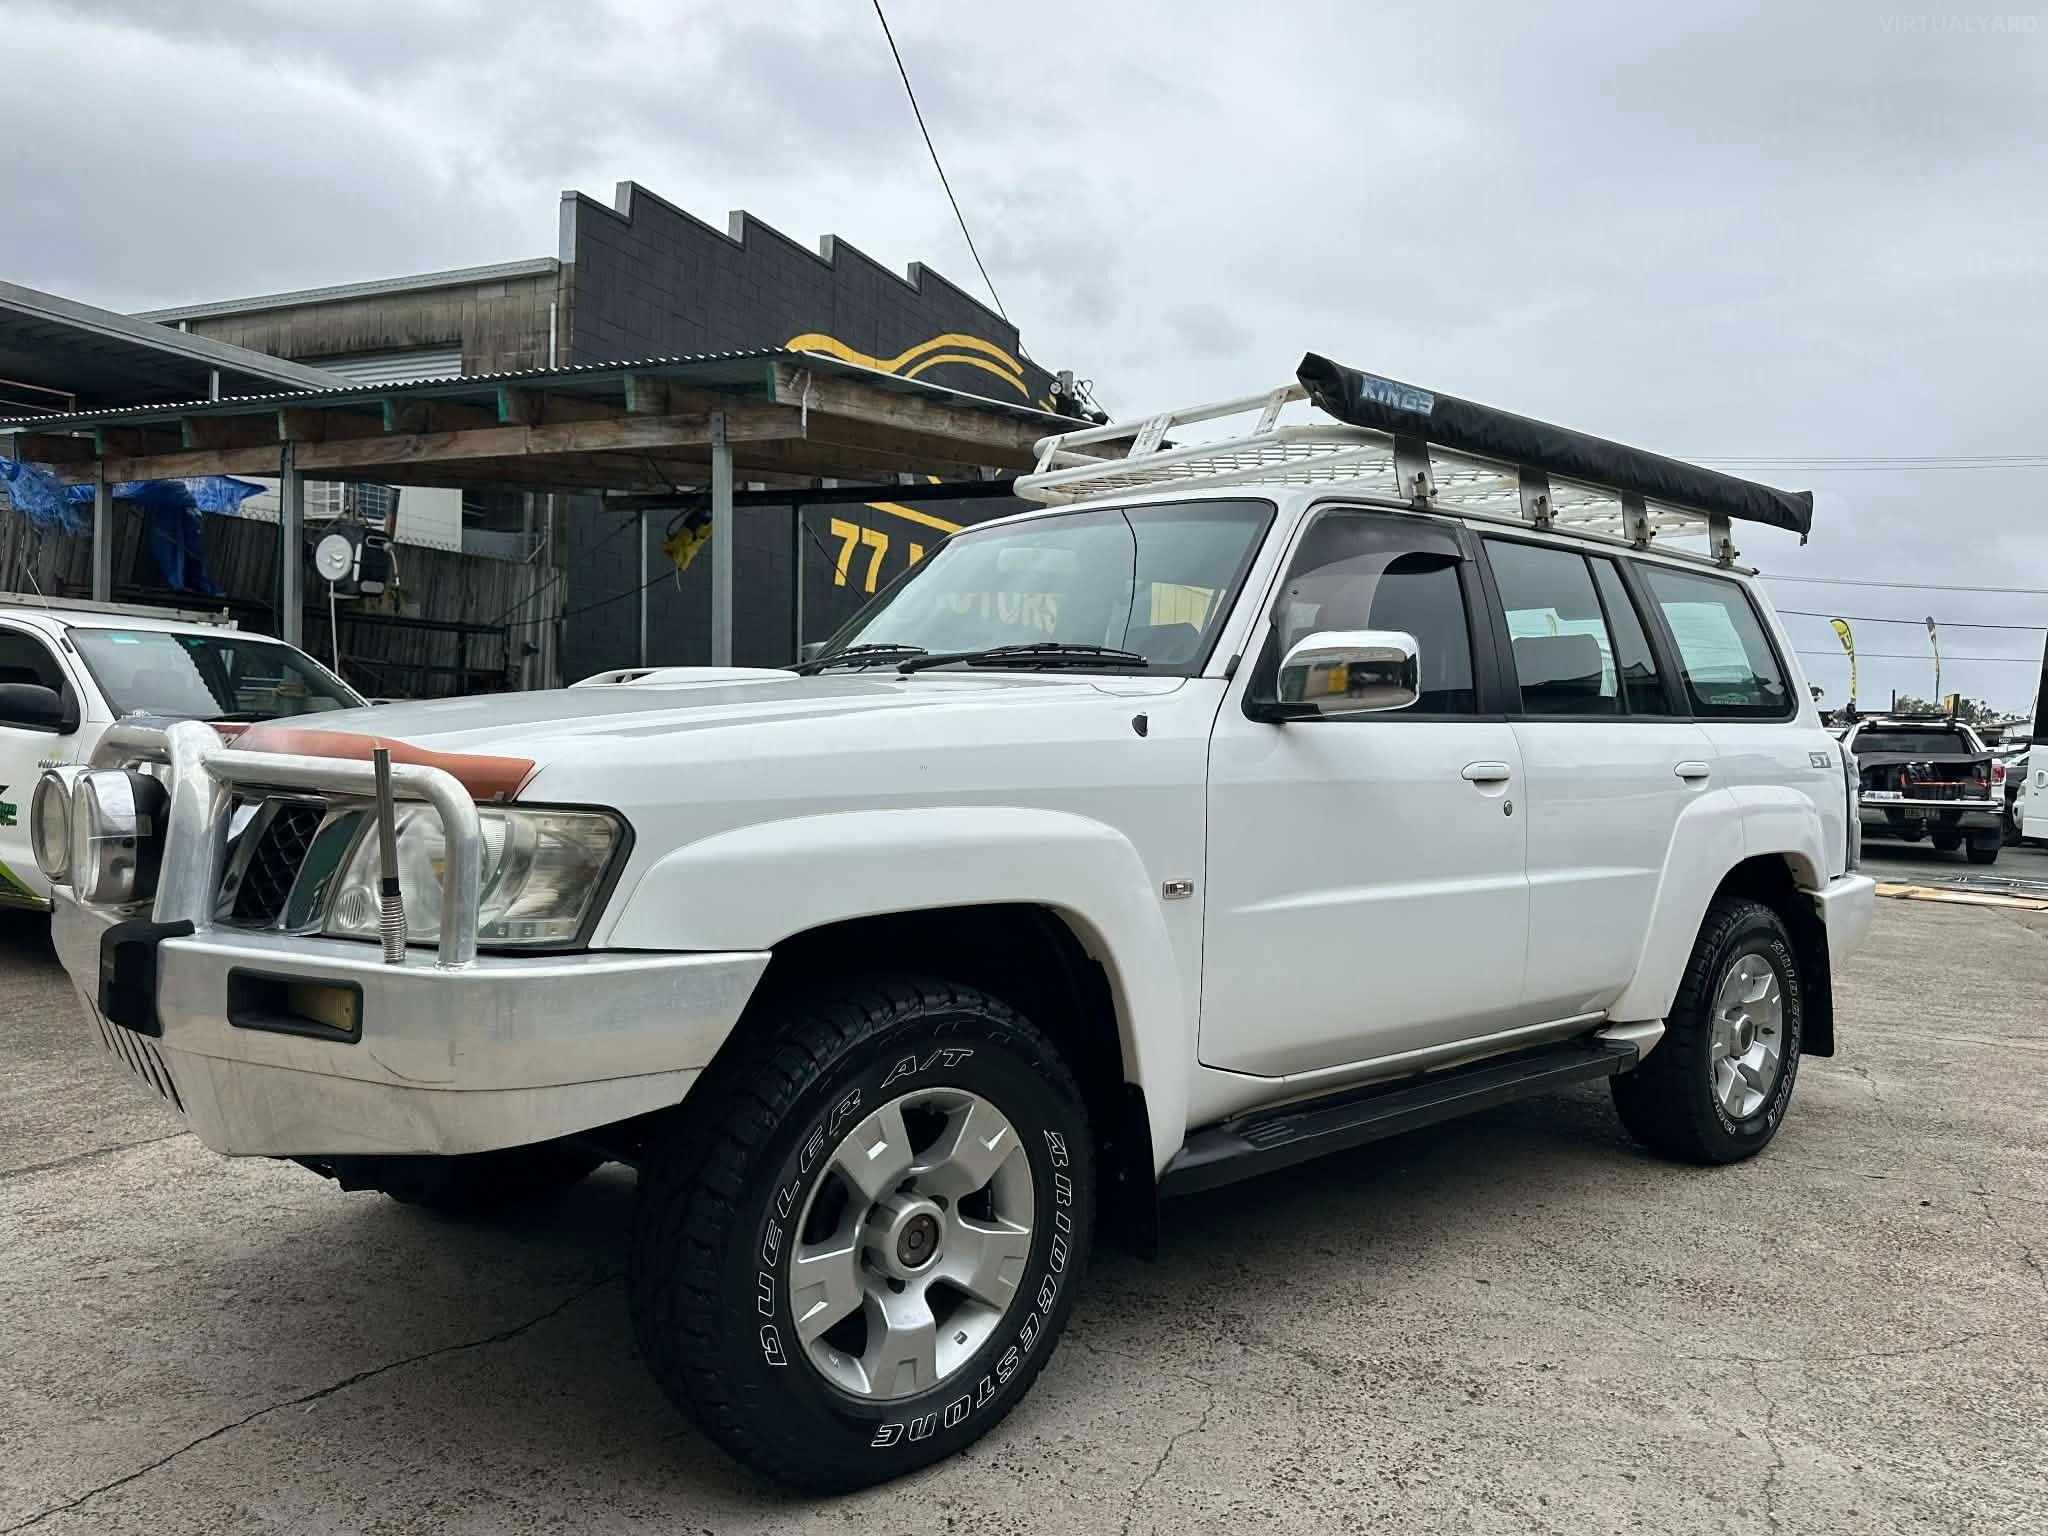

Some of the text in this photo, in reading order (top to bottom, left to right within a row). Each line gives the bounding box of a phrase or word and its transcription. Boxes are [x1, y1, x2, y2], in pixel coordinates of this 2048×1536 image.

[831, 518, 889, 593] 77
[754, 1048, 974, 1366] DUELER A/T
[872, 1130, 1072, 1448] BRIDGESTONE
